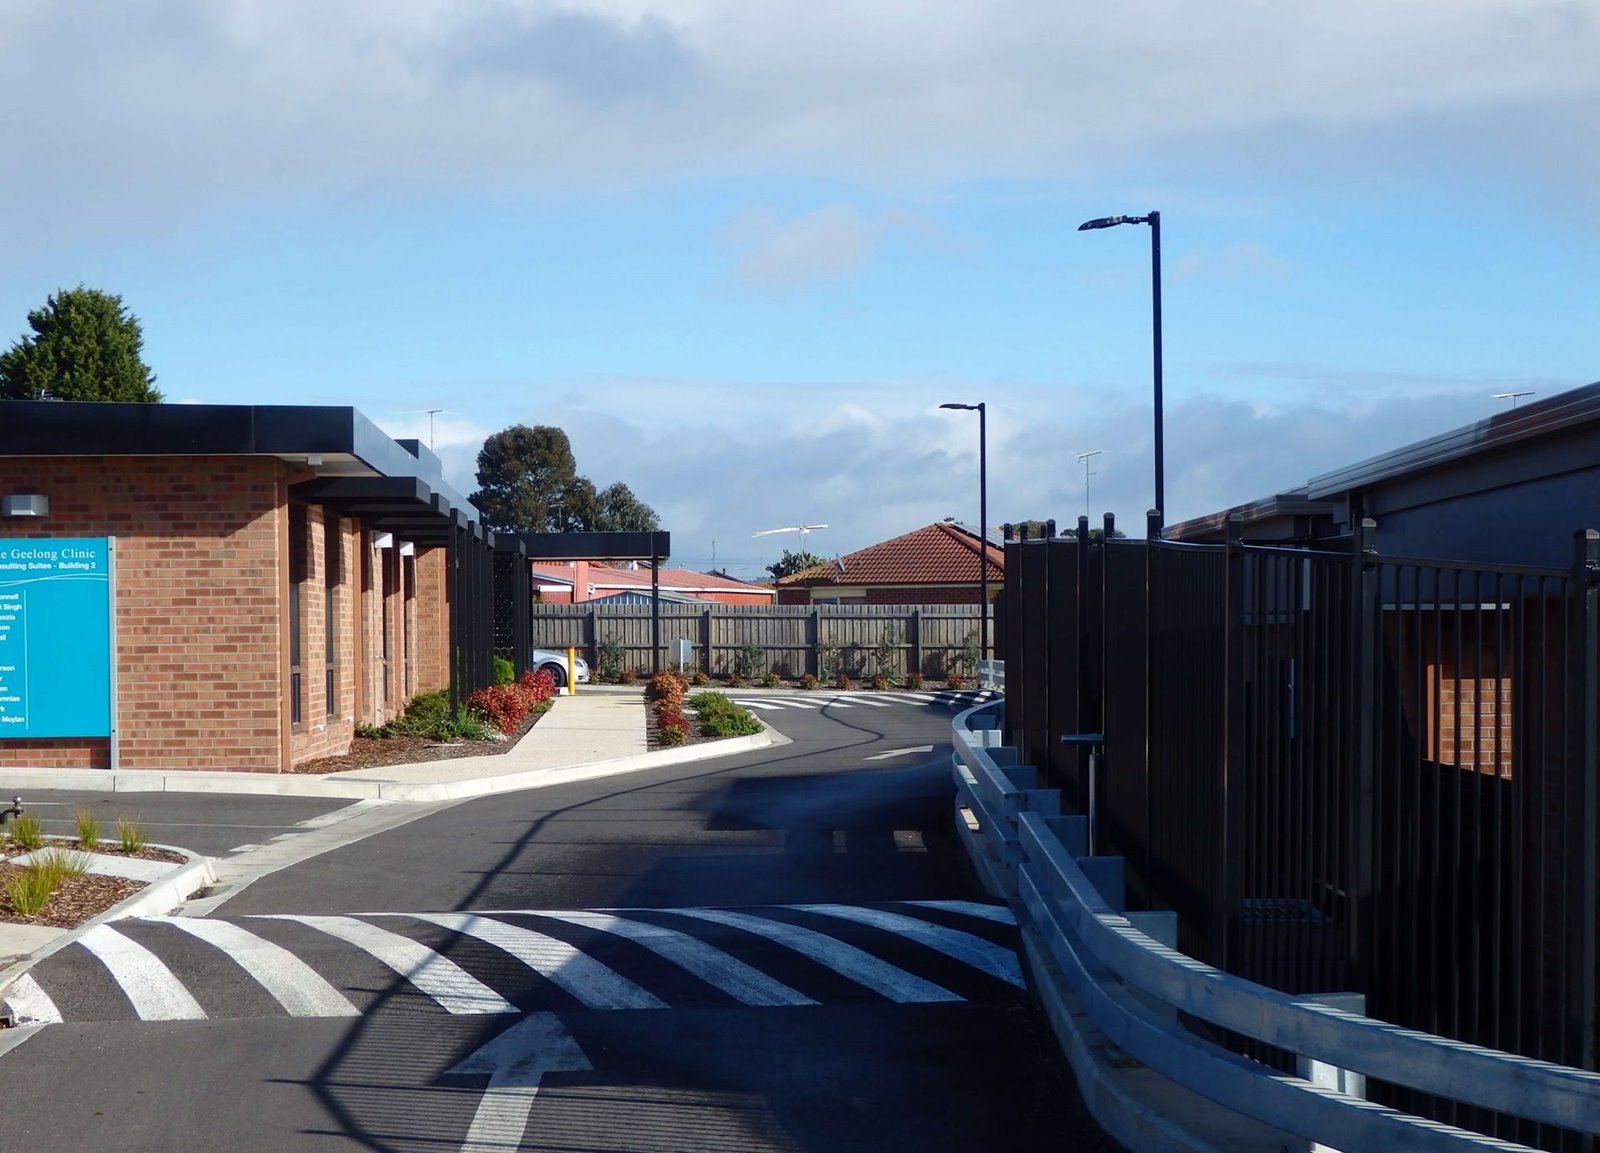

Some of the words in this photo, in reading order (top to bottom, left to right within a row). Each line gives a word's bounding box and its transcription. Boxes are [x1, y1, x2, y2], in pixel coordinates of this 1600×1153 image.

[11, 548, 58, 561] Geelong
[61, 548, 96, 559] Clinic
[28, 562, 52, 570] Suites
[58, 562, 89, 570] Building
[3, 603, 22, 611] Singh
